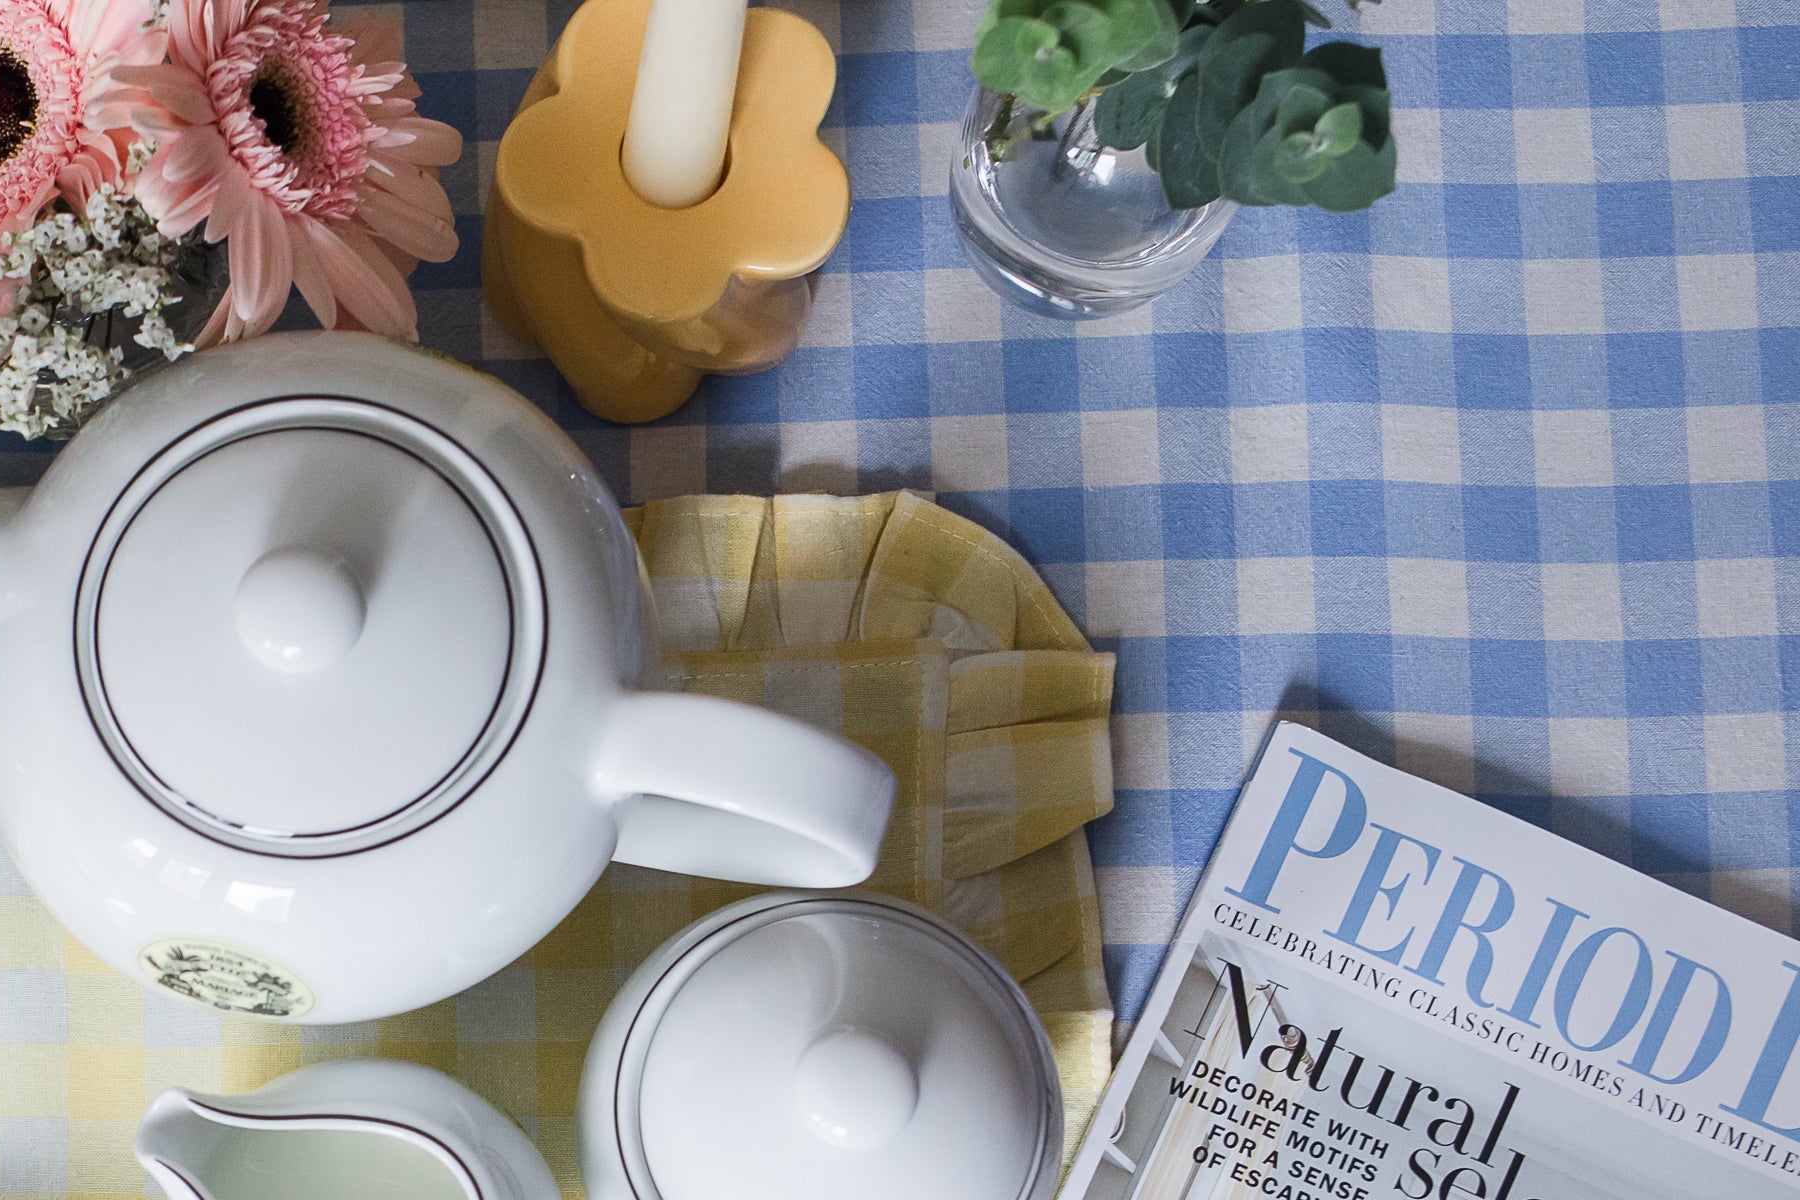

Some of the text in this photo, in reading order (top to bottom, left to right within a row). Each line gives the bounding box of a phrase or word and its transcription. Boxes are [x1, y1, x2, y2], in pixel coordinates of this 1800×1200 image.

[1224, 748, 1732, 1084] PERIOD
[1183, 957, 1521, 1169] Natural
[1215, 904, 1800, 1177] CELEBRATING CLASSIC HOMES AND TIMELE
[1169, 1077, 1377, 1182] WILDLIFE MOTIFS
[1192, 1060, 1389, 1159] DECORATE WITH
[1193, 1144, 1225, 1168] OF
[1205, 1124, 1256, 1157] FOR
[1263, 1151, 1278, 1169] A
